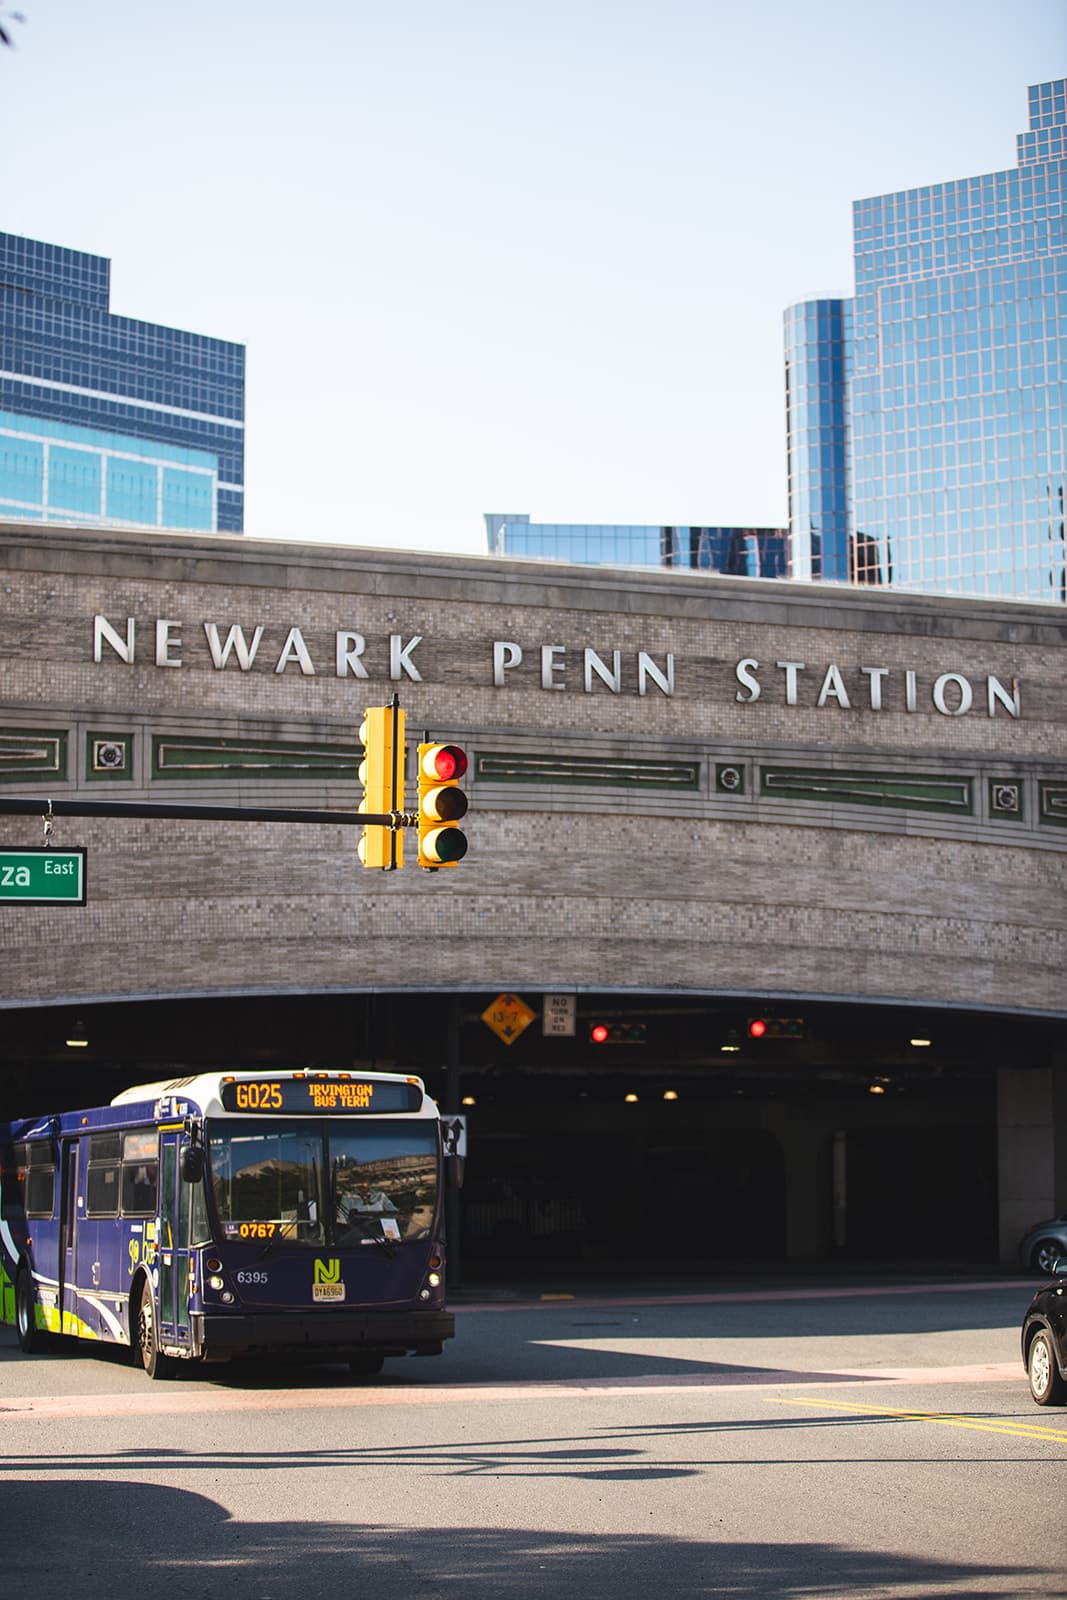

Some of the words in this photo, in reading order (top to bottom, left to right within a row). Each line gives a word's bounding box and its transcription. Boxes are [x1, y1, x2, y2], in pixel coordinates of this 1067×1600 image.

[93, 614, 424, 683] NEWARK
[492, 640, 676, 697] PENN
[735, 657, 1021, 720] STATION
[44, 860, 75, 875] East
[552, 998, 568, 1007] NO
[308, 1084, 373, 1096] IRVINGTON
[313, 1096, 336, 1107] BUS
[340, 1096, 369, 1107] TERM
[239, 1223, 276, 1239] 0767
[236, 1271, 269, 1284] 6395
[314, 1258, 341, 1284] NJ
